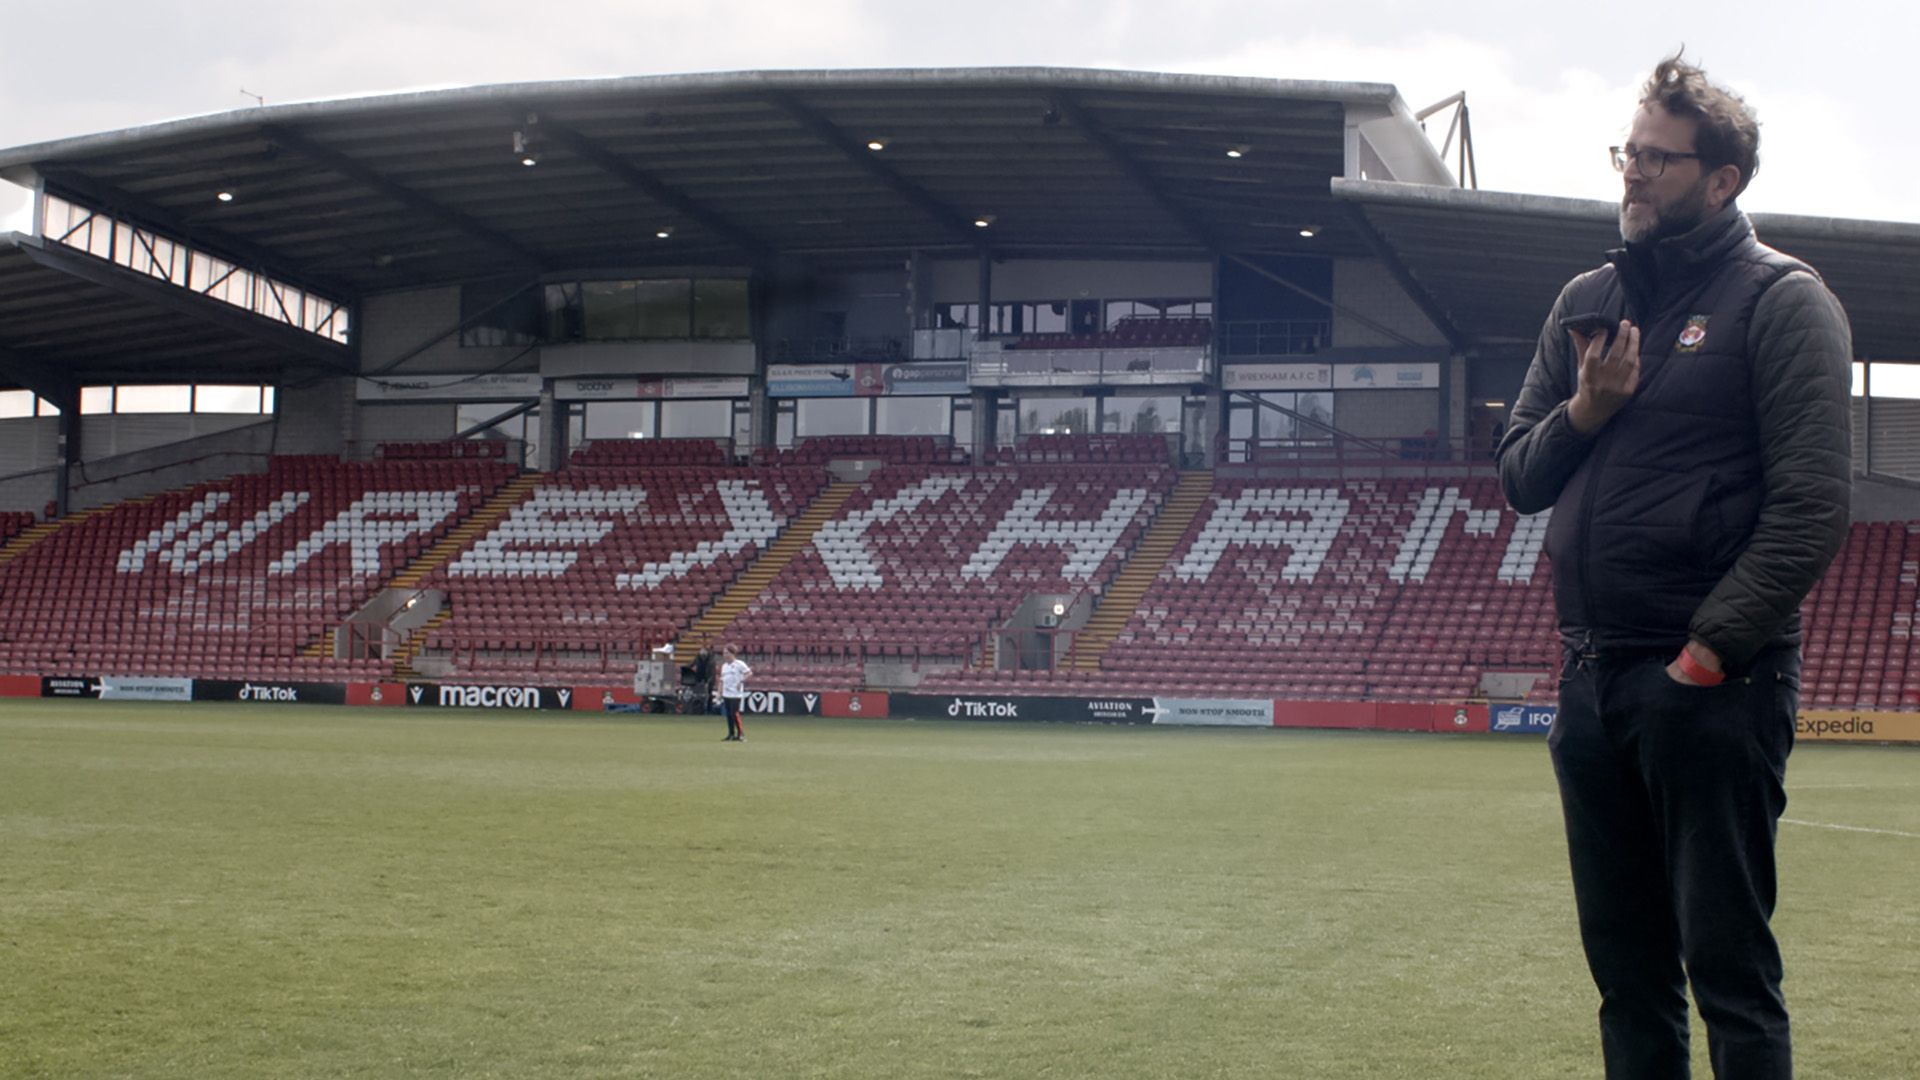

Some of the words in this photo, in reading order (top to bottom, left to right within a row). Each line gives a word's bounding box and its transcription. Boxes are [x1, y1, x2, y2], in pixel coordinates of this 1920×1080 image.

[1238, 372, 1287, 382] WREXHAM
[253, 685, 297, 701] TikTok
[439, 685, 540, 708] macron
[964, 701, 1018, 717] TikTok
[1088, 701, 1132, 711] AVIATION
[1225, 708, 1265, 717] SMOOTH
[1795, 716, 1874, 737] Expedia
